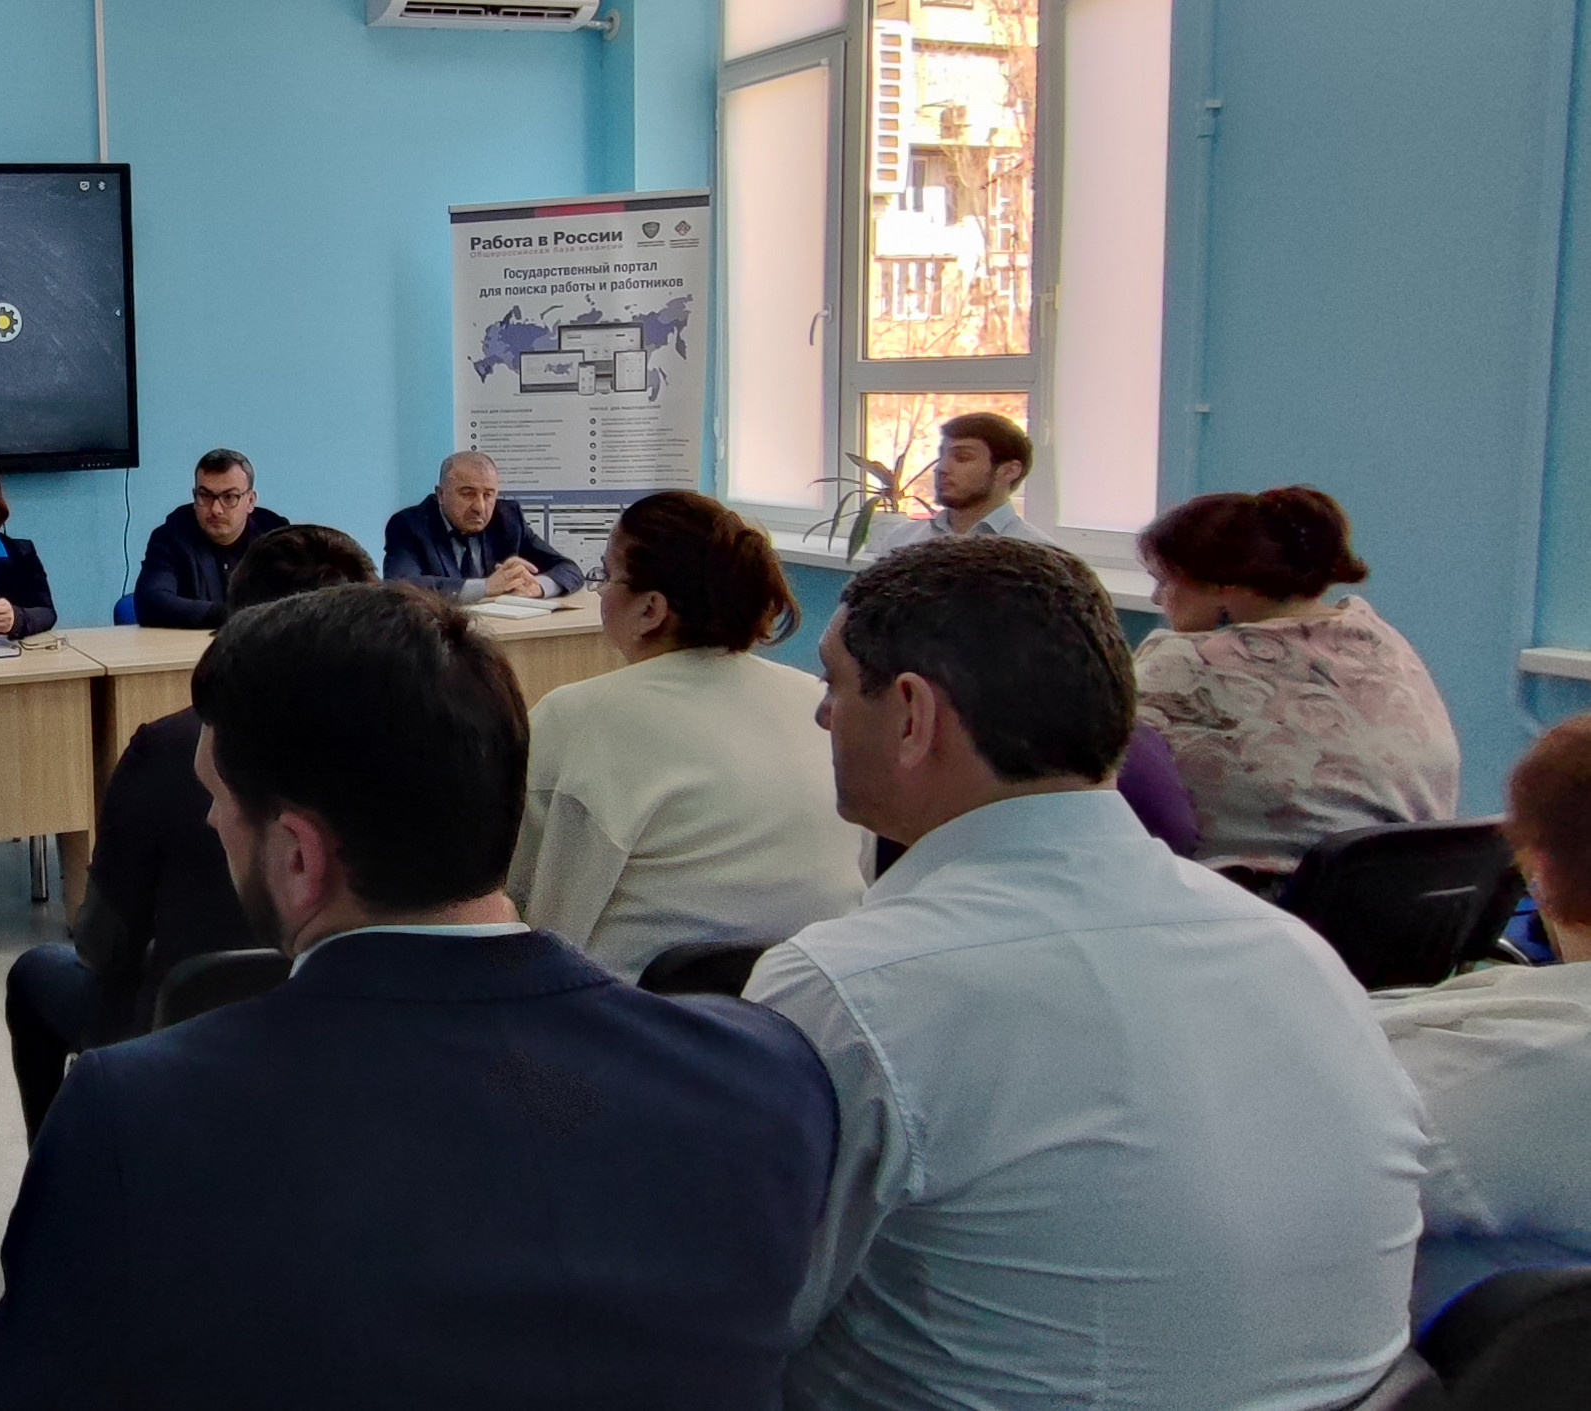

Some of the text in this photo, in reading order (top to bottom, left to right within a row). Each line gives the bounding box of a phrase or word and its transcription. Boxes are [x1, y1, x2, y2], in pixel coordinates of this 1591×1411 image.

[470, 235, 533, 251] Работа
[538, 236, 549, 247] в
[553, 231, 623, 246] России
[503, 261, 658, 280] Государственный портал
[479, 277, 684, 299] для поиска работы и работников
